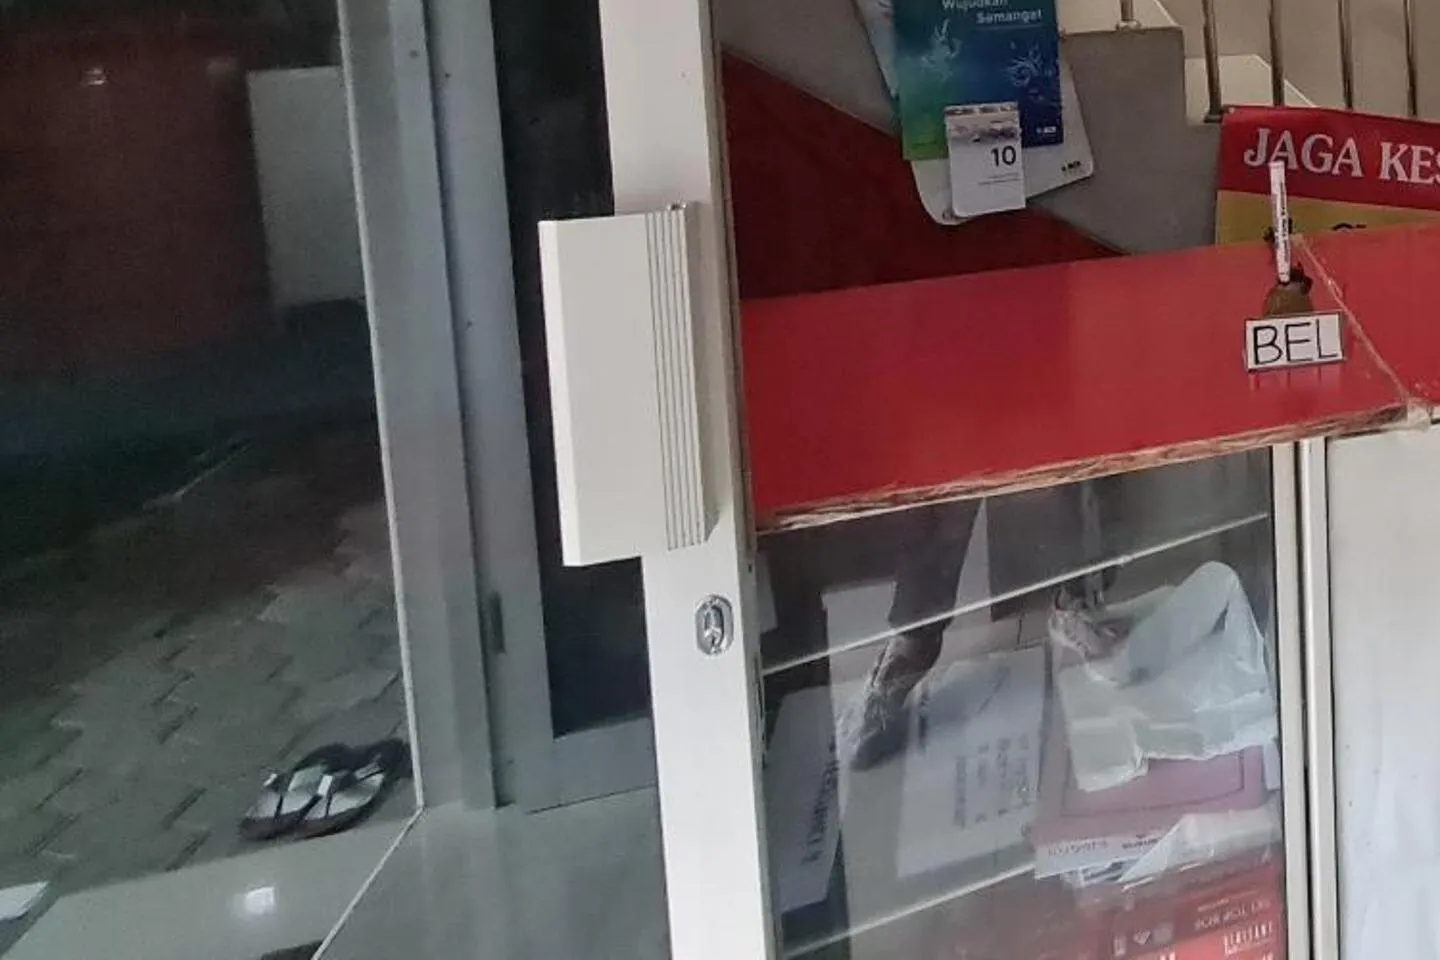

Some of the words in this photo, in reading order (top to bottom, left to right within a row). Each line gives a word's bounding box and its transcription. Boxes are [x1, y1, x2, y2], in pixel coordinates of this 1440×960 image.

[975, 8, 1043, 25] Semangat
[991, 145, 1017, 167] 10
[1243, 127, 1364, 179] JAGA
[1252, 318, 1338, 366] BEL
